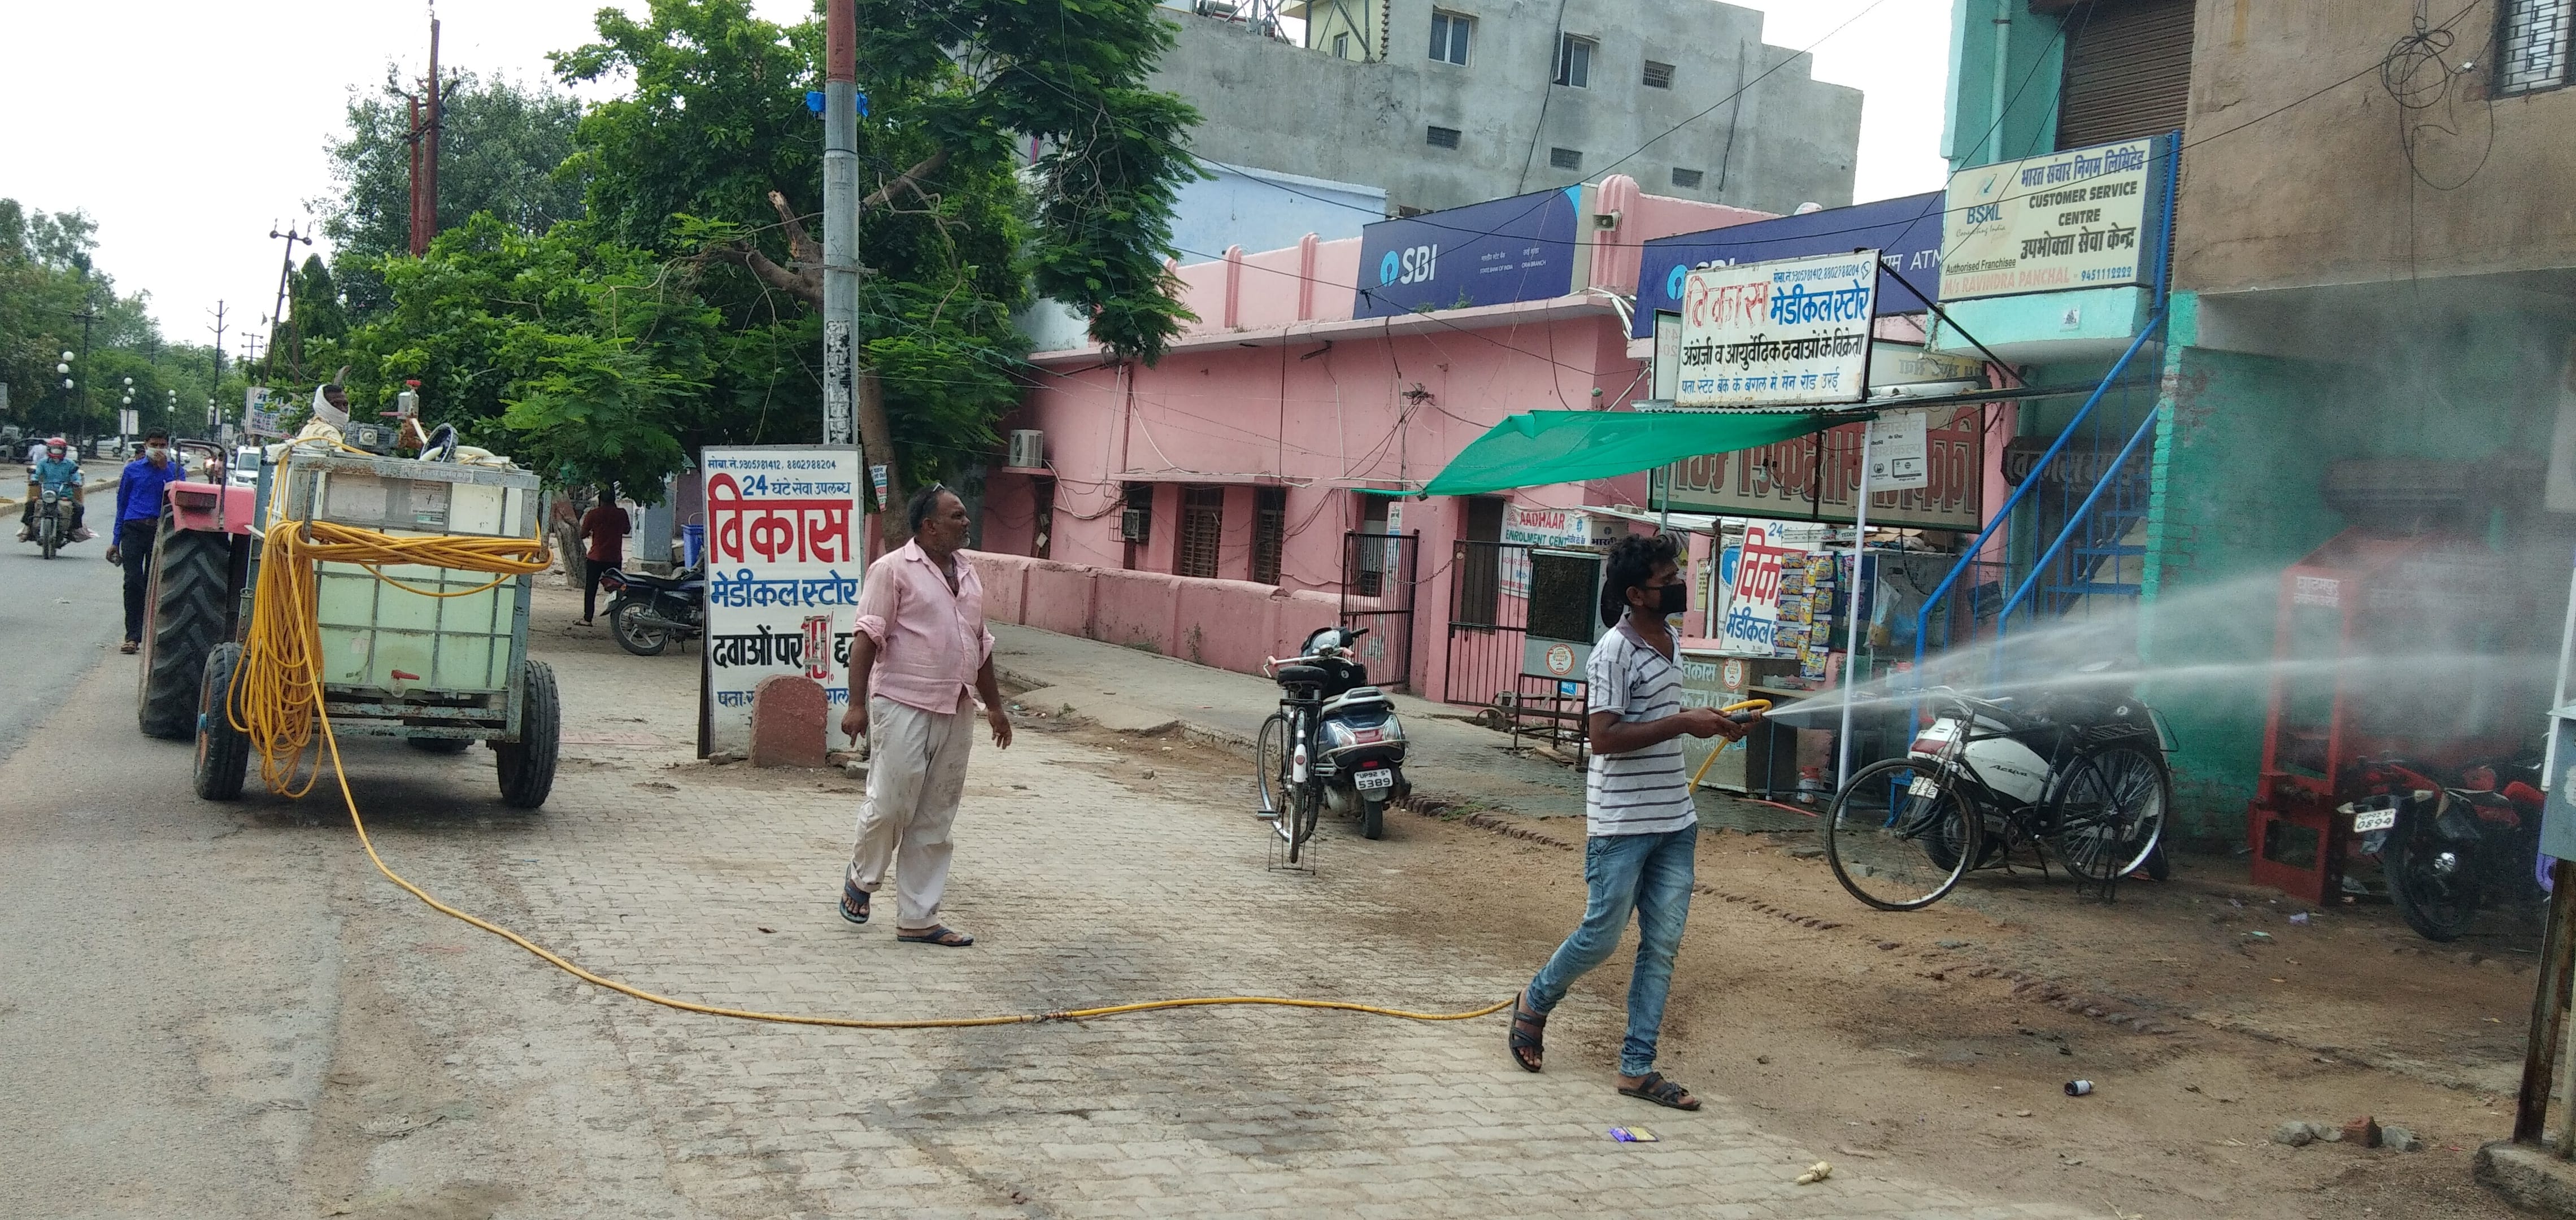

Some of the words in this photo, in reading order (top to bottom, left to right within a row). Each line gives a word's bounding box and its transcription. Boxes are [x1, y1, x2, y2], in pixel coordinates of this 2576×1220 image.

[2021, 166, 2045, 187] भारत
[2047, 157, 2072, 184] संचार
[2074, 154, 2102, 180] निगम
[2029, 188, 2087, 209] CUSTOMER
[2089, 181, 2138, 201] SERVICE
[1966, 204, 2003, 225] BSNL
[2059, 208, 2101, 226] CENTRE
[2078, 226, 2105, 254] सेवा
[2107, 222, 2136, 250] केन्द्र
[1400, 244, 1438, 284] SBI
[1946, 260, 1980, 274] Authorised
[1981, 258, 2016, 270] Franchisee
[1962, 272, 2015, 293] RAVINDRA
[2018, 267, 2070, 287] PANCHAL
[743, 474, 768, 496] 24
[708, 473, 854, 564] विकास
[1520, 511, 1565, 530] AADHAAR
[1768, 522, 1783, 537] 24
[1505, 529, 1547, 545] ENROLMENT
[1549, 535, 1568, 547] CENT
[711, 568, 799, 607] मेडीकल
[802, 569, 858, 608] स्टोर
[712, 624, 773, 669] दवाओं
[774, 633, 804, 669] पर
[1359, 778, 1390, 788] 5389
